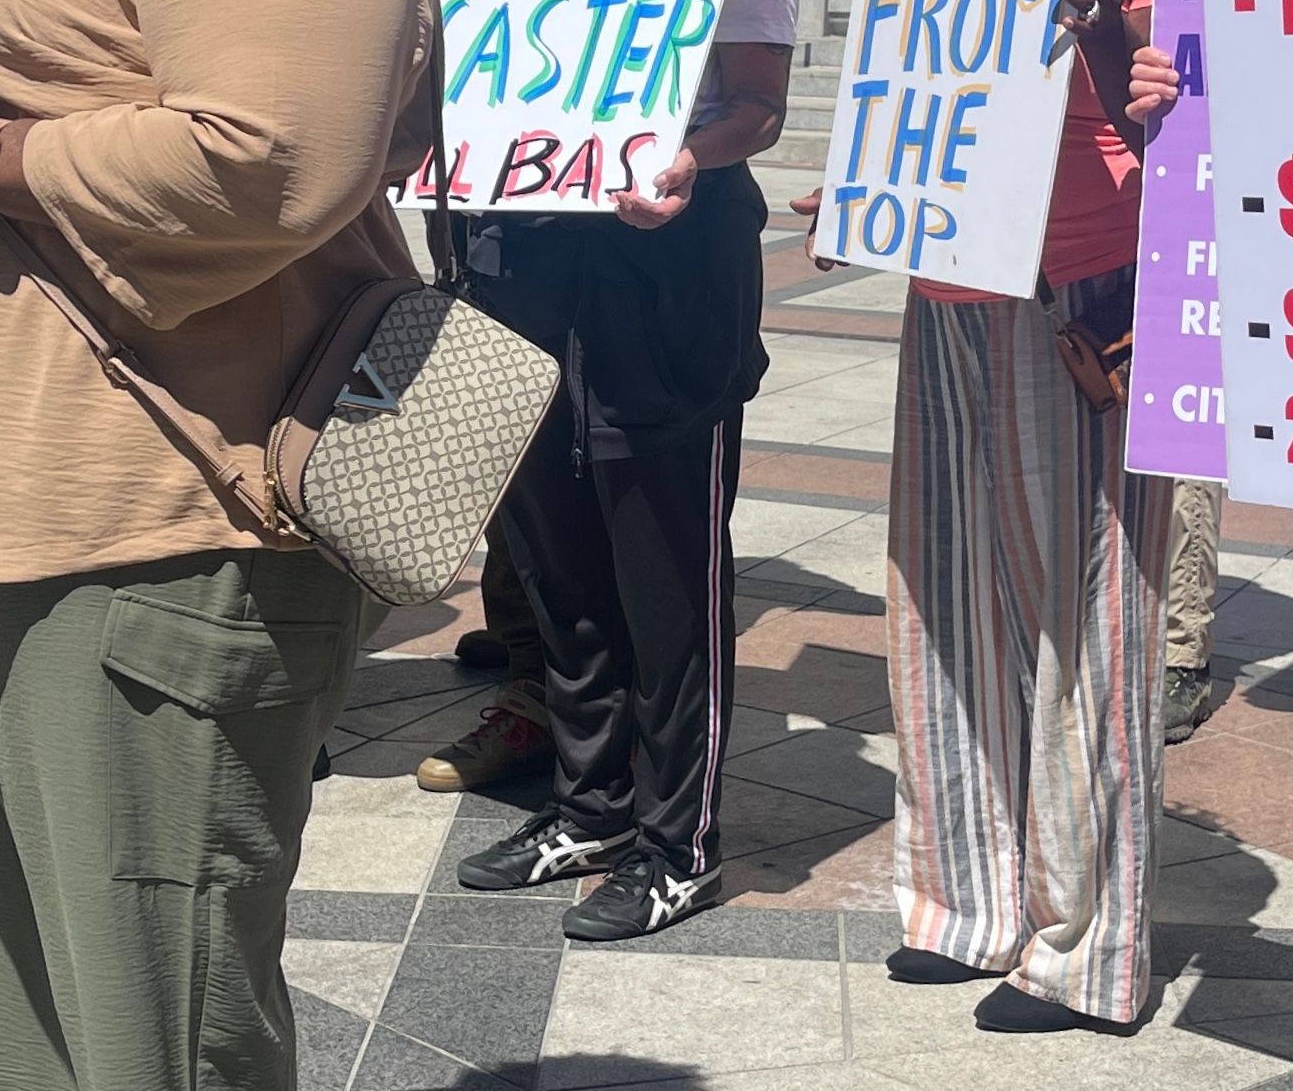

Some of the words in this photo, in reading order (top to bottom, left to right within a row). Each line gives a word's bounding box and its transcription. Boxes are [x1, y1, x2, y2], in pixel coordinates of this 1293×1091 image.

[489, 129, 658, 206] BAS
[846, 80, 992, 191] THE
[835, 186, 958, 271] TOP
